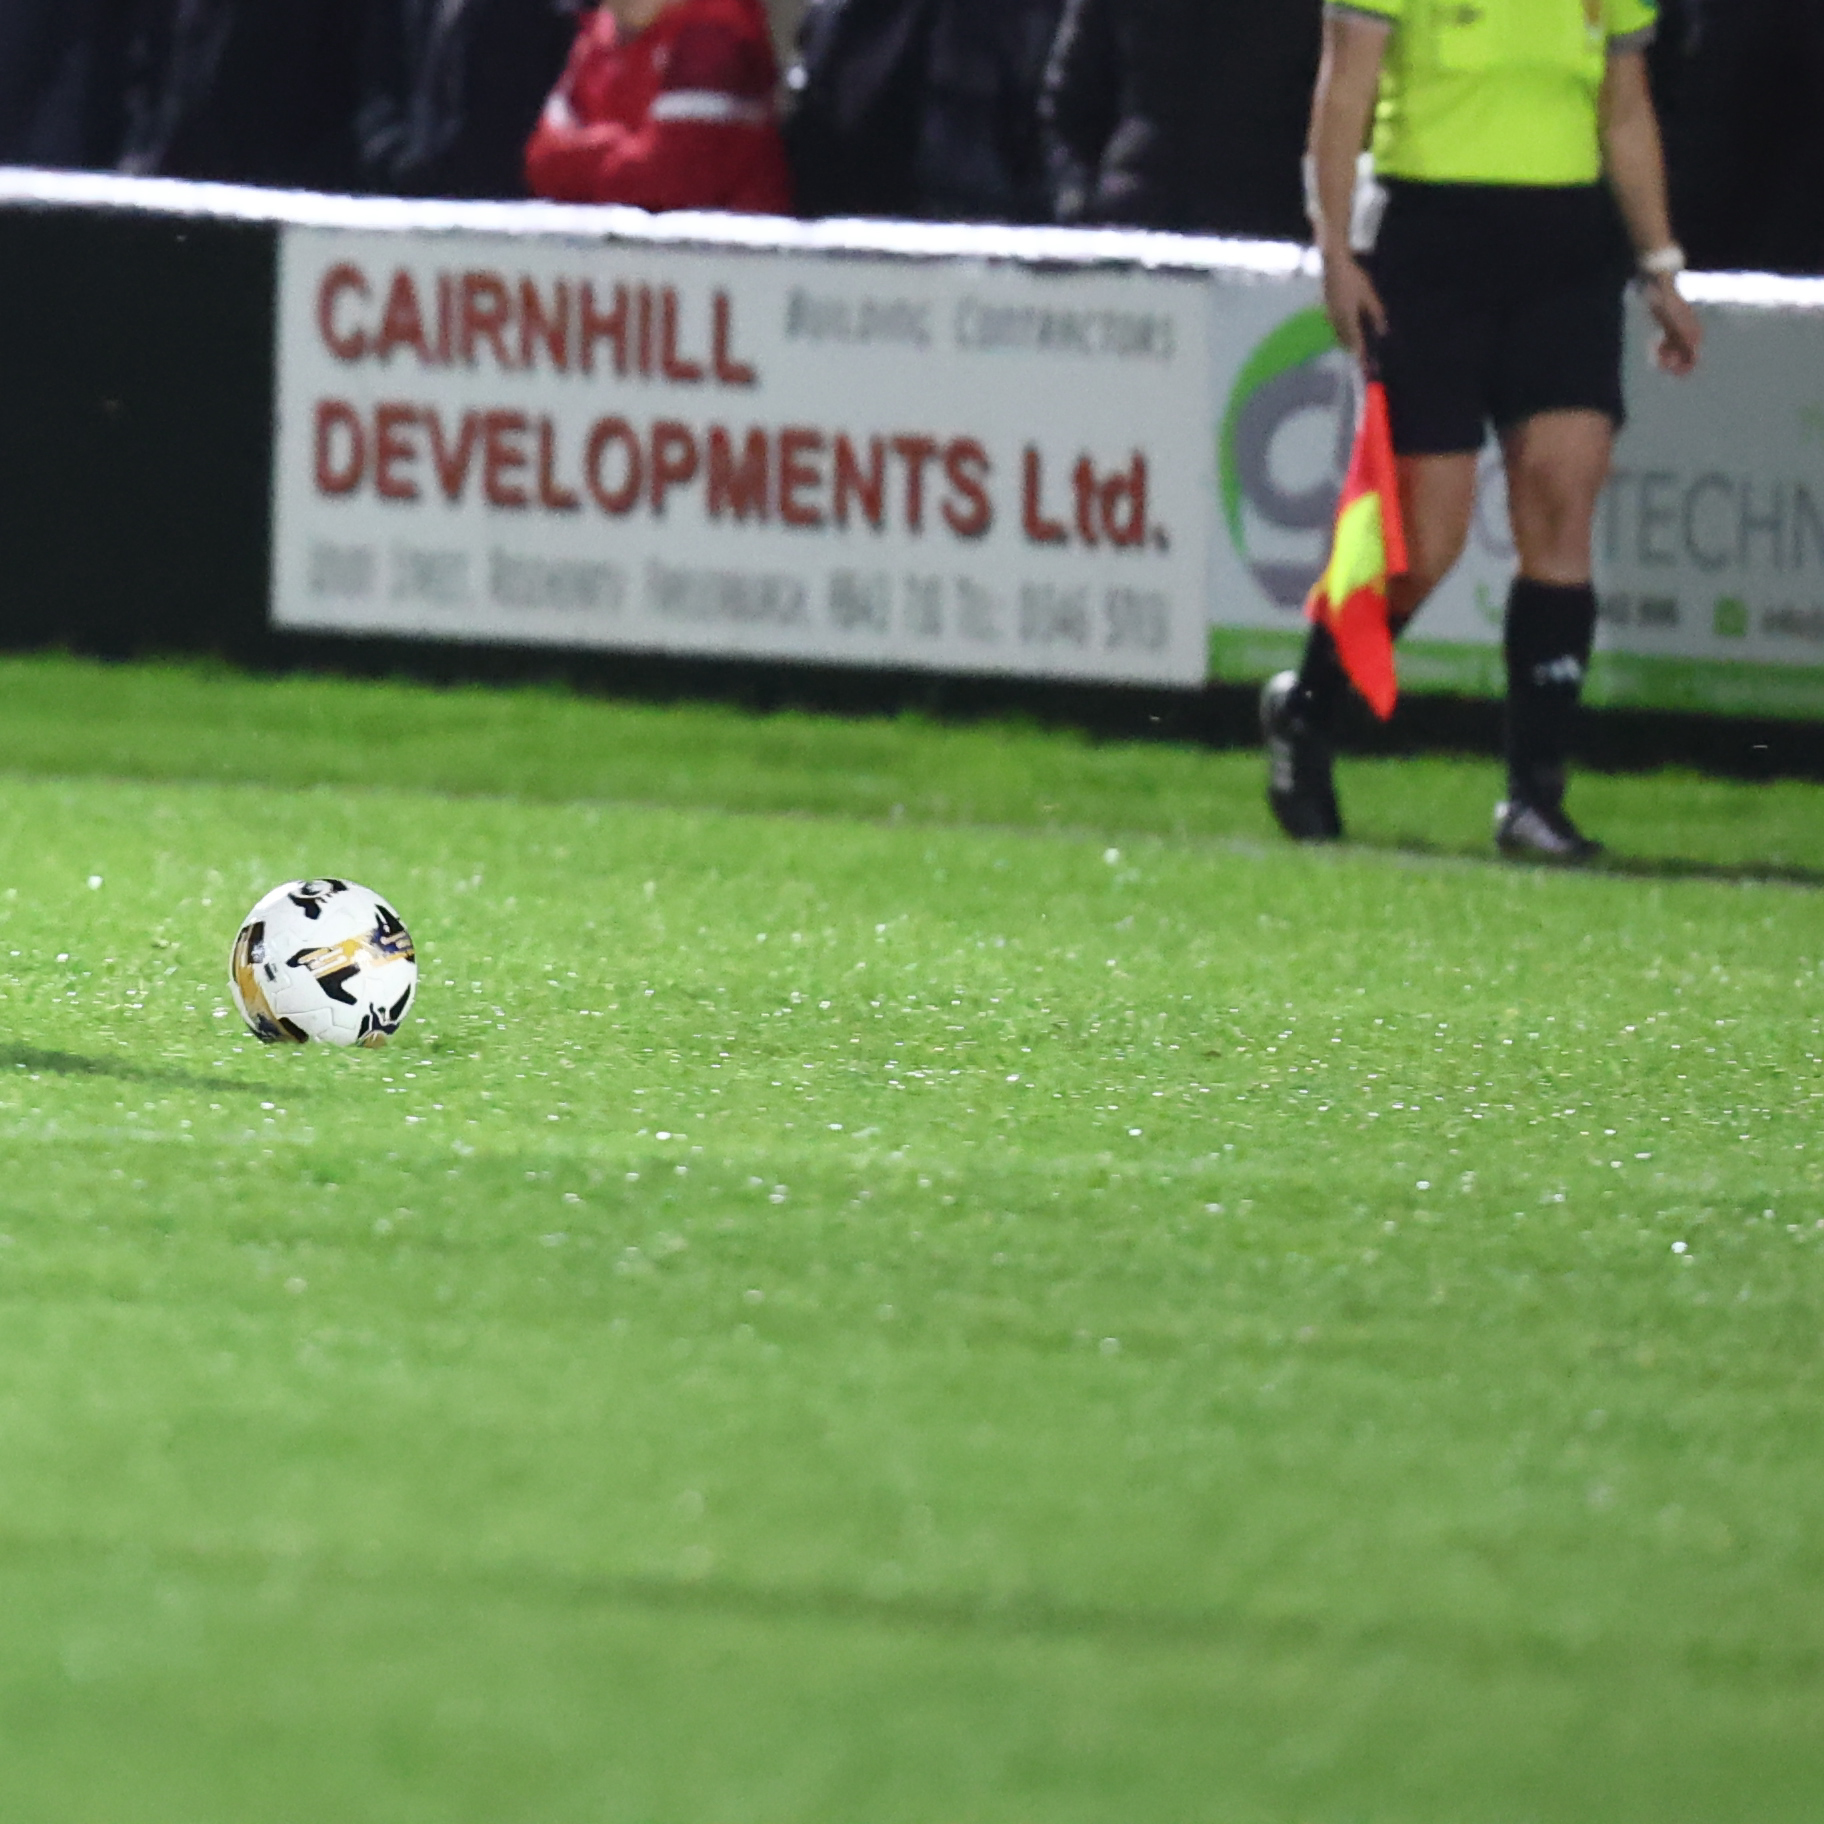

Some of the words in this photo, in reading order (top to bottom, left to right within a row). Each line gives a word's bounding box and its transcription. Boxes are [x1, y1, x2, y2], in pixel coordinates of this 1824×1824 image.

[316, 260, 758, 390] CAIRNHILL
[314, 395, 994, 540] DEVELOPMENTS
[1020, 439, 1171, 552] Ltd.
